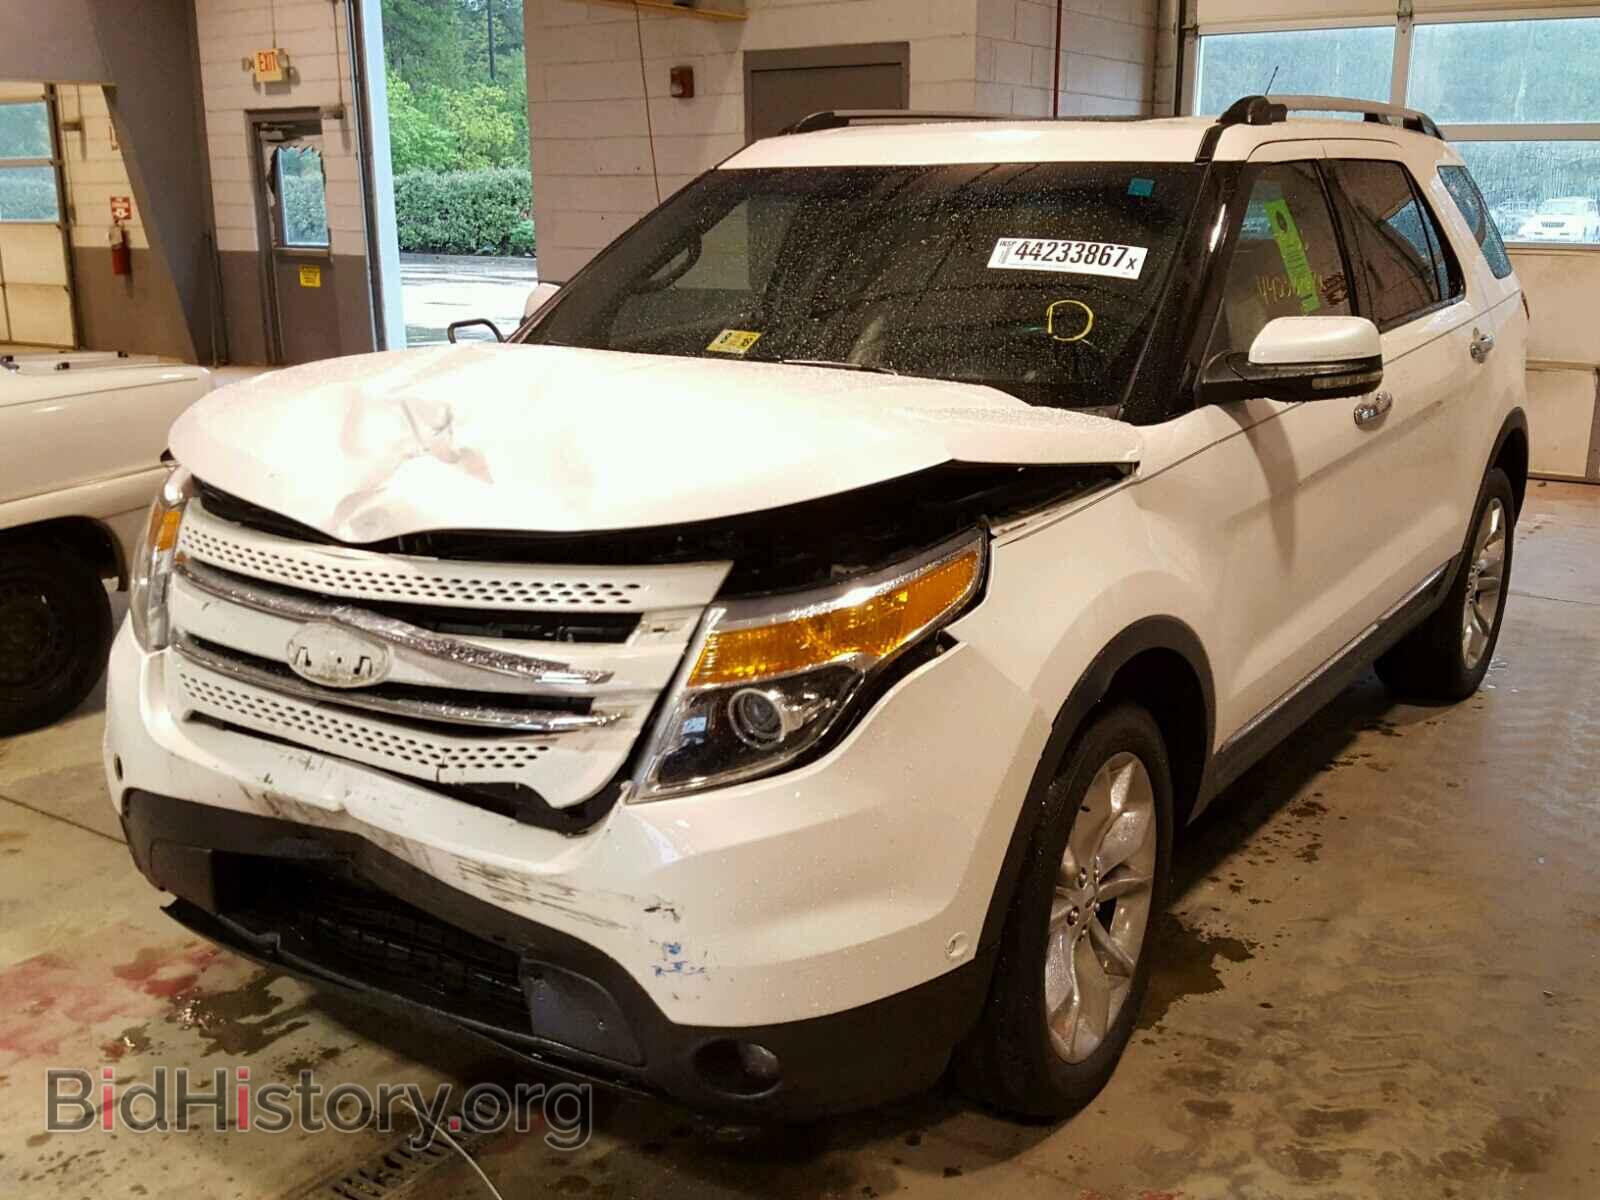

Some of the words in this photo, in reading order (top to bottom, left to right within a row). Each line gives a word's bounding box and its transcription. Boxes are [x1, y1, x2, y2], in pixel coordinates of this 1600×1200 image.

[258, 52, 278, 71] EXIT
[1014, 240, 1129, 268] 44233867
[1046, 299, 1094, 341] D
